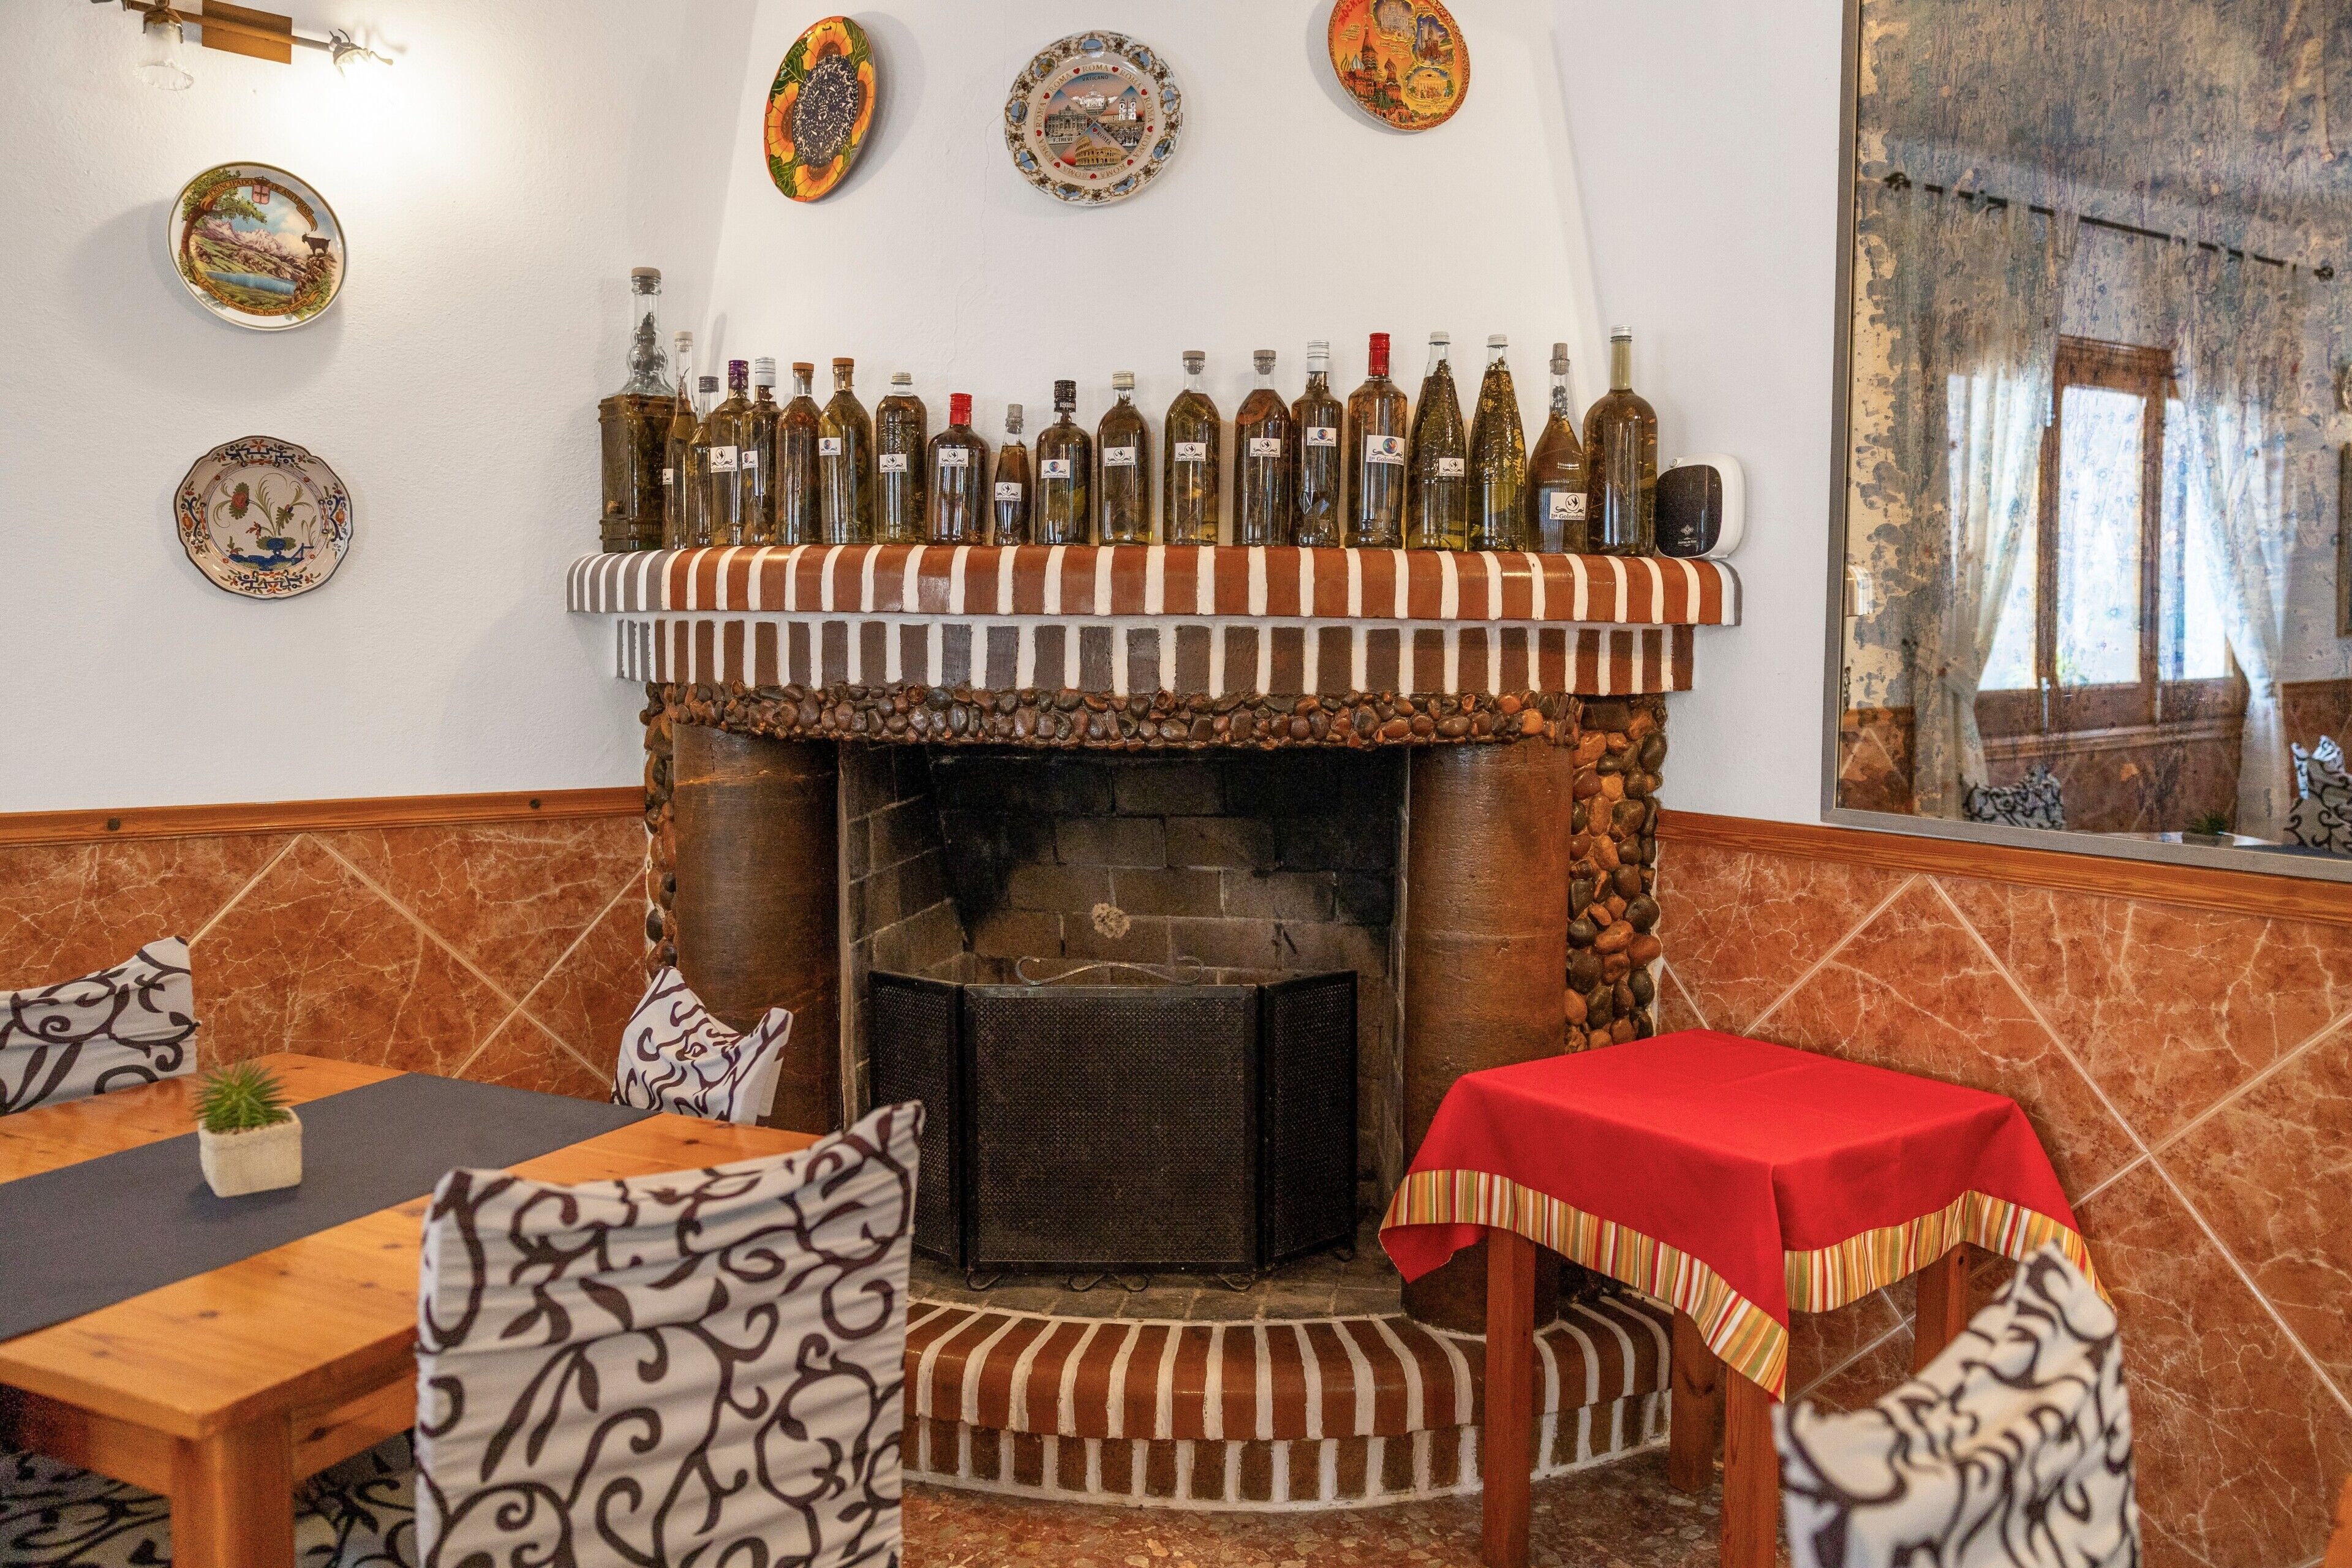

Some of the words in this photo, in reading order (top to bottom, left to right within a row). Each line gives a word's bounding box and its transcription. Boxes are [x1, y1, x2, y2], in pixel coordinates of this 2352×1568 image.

[1049, 74, 1072, 92] ROMA
[1119, 70, 1142, 88] ROMA
[1036, 102, 1046, 127] ROMA
[1144, 97, 1154, 123] ROMA
[1096, 131, 1112, 145] ROMA
[1133, 134, 1152, 157] ROMA
[1038, 138, 1055, 162] ROMA
[1063, 166, 1088, 178] ROMA
[1100, 164, 1126, 178] ROMA
[208, 179, 253, 196] PRINCIPADO
[282, 189, 311, 215] ASTURIAS
[226, 300, 259, 315] Covadonga
[288, 300, 307, 312] Europa
